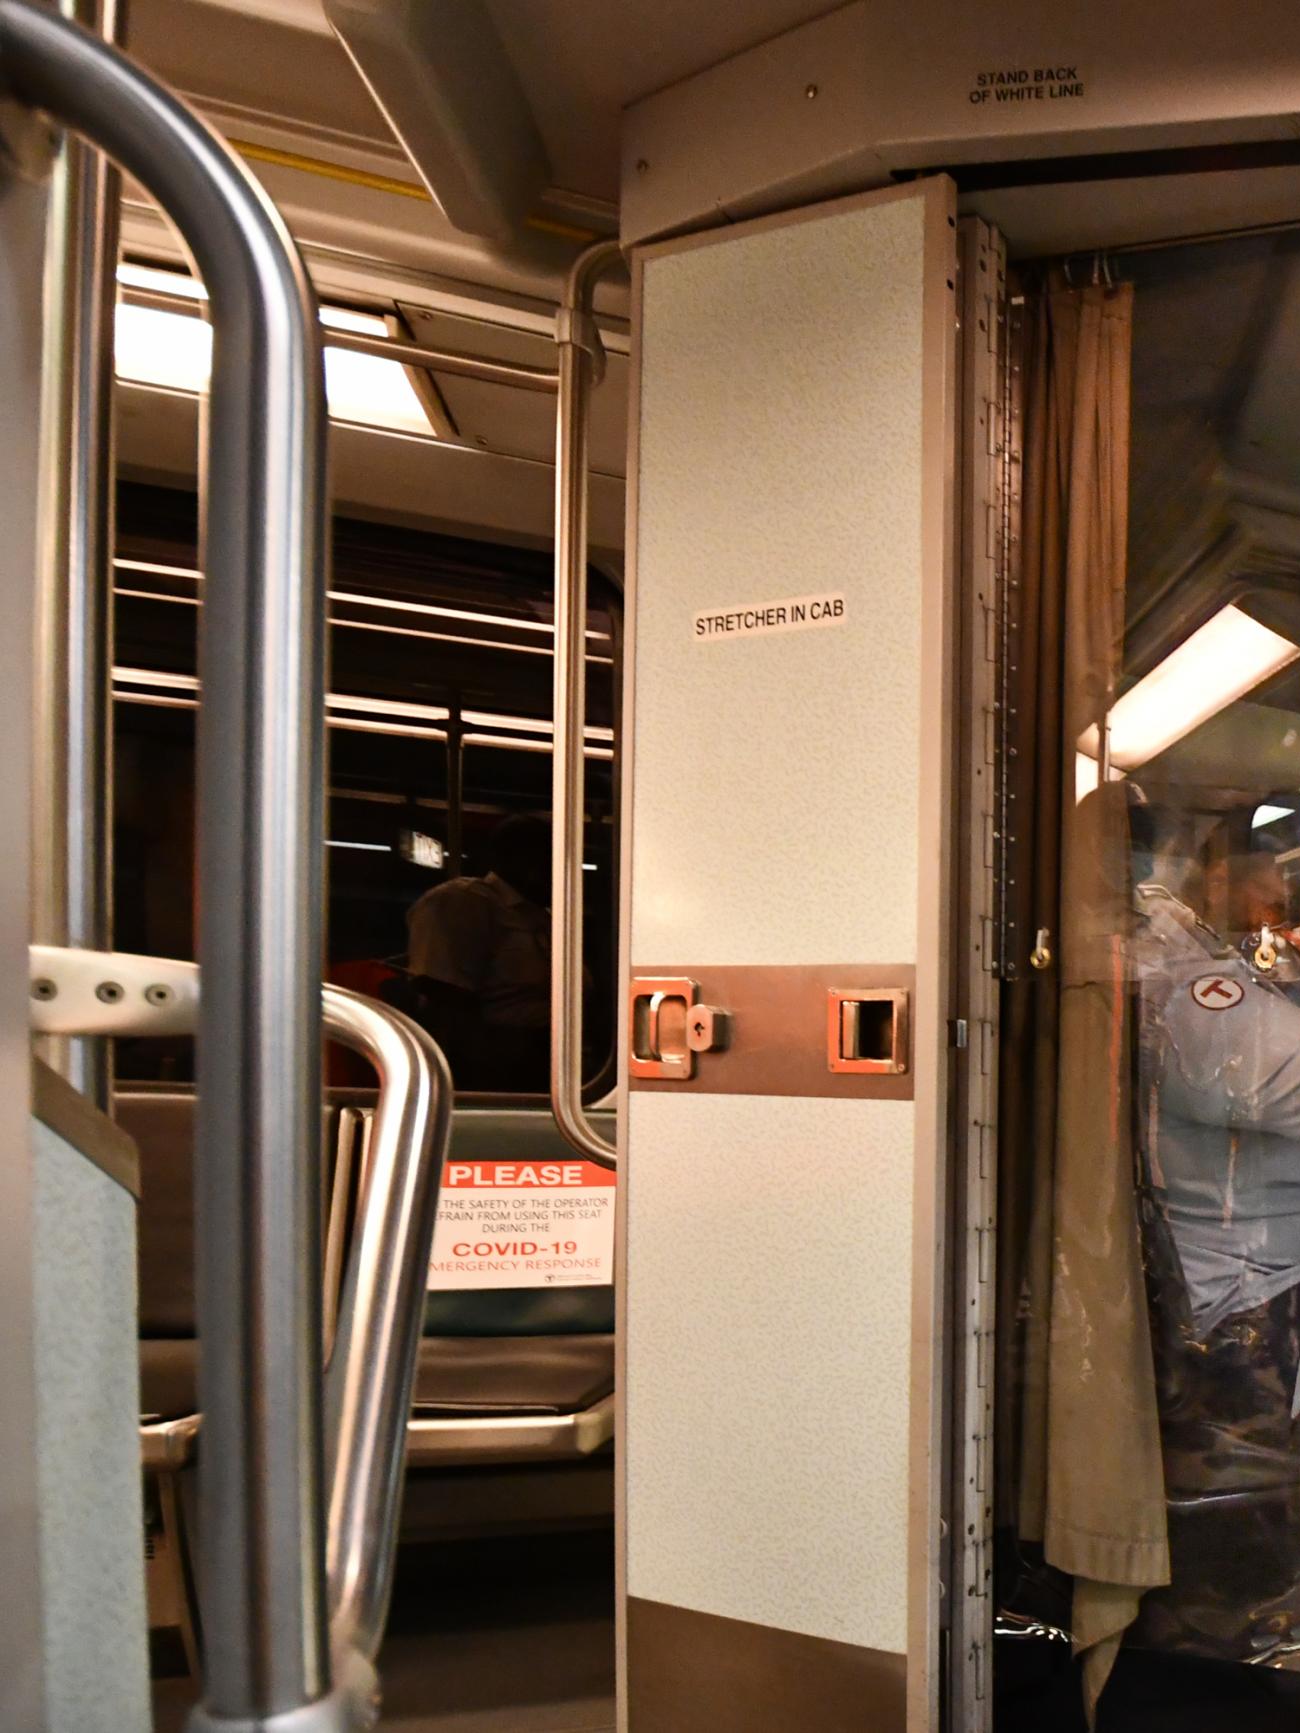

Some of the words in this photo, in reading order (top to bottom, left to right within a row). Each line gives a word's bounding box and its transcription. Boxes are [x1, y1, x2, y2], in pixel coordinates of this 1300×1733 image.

[977, 70, 1028, 86] STAND
[1034, 67, 1077, 82] BACK
[969, 89, 990, 104] OF
[995, 86, 1044, 102] WHITE
[1049, 83, 1085, 98] LINE
[696, 607, 786, 635] STRETCHER
[790, 604, 806, 623] IN
[810, 599, 844, 620] CAB
[449, 1165, 583, 1186] PLEASE
[444, 1199, 465, 1209] THE
[469, 1199, 508, 1209] SAFETY
[512, 1199, 527, 1209] OF
[531, 1199, 551, 1209] THE
[554, 1198, 608, 1209] OPERATOR
[478, 1211, 511, 1221] FROM
[514, 1210, 549, 1220] USING
[552, 1210, 575, 1220] THIS
[578, 1209, 601, 1219] SEAT
[482, 1223, 527, 1233] DURING
[531, 1223, 550, 1233] THE
[452, 1241, 577, 1257] COVID-19
[429, 1261, 520, 1272] MERGENCY
[525, 1258, 602, 1270] RESPONSE
